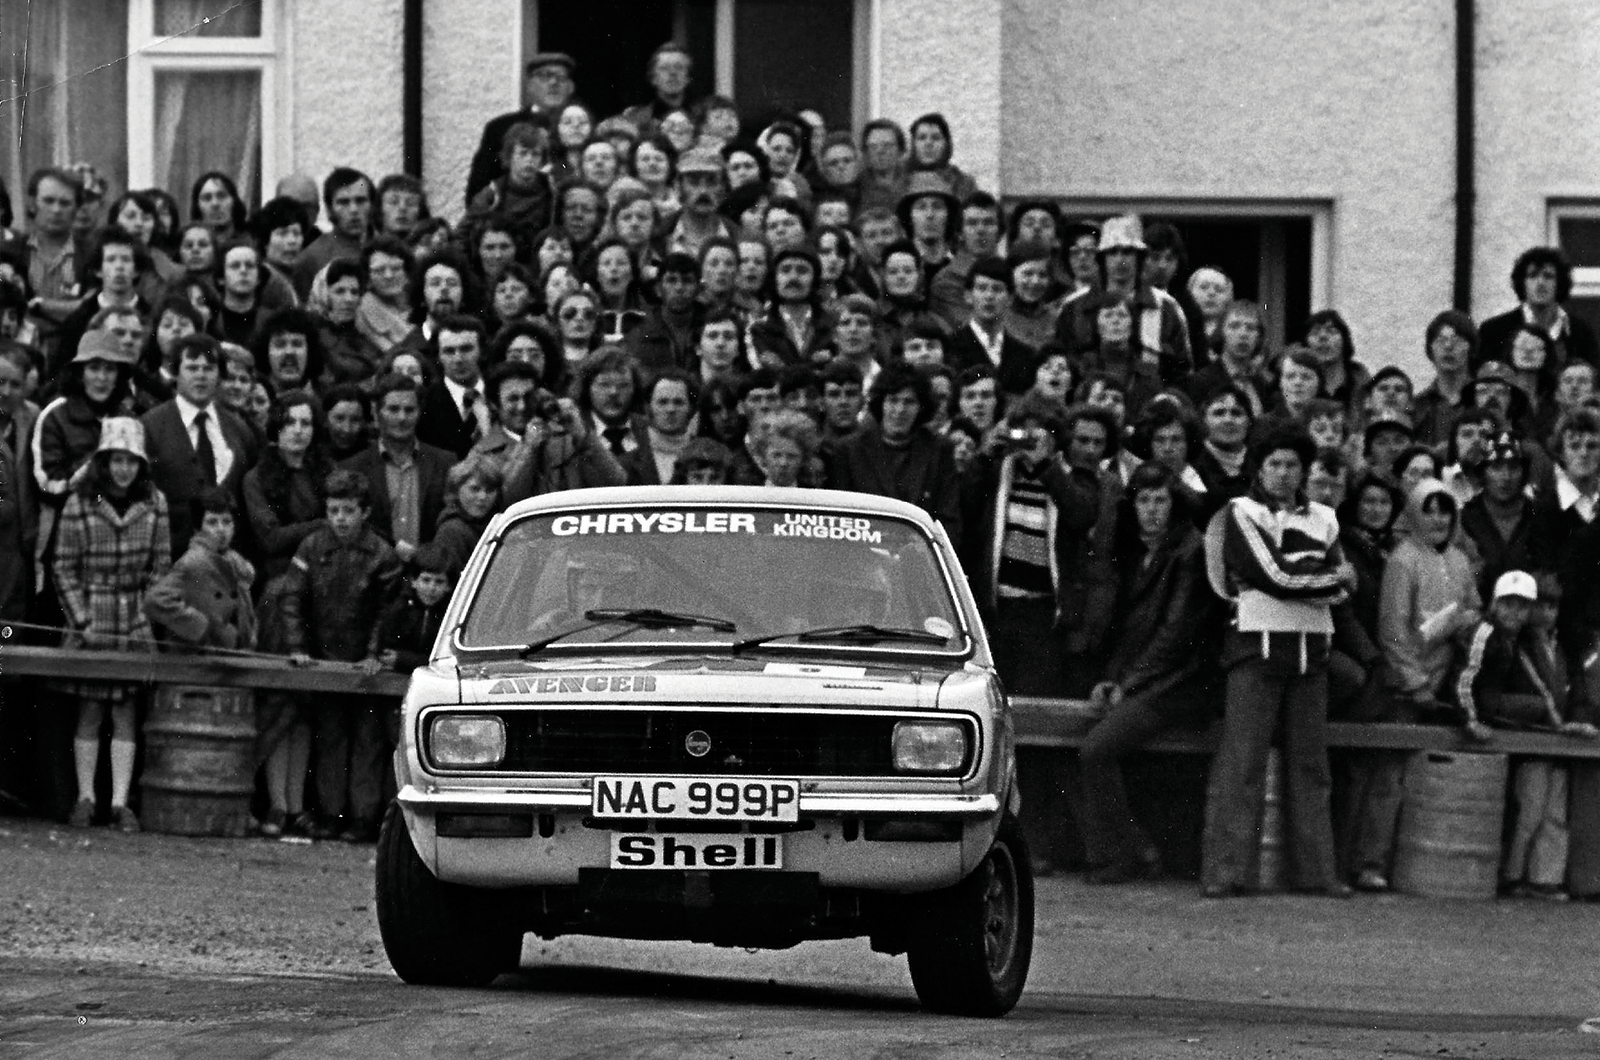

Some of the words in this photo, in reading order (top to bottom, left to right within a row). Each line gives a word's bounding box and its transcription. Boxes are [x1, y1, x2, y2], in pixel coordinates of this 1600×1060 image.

[551, 513, 755, 536] CHRYSLER
[784, 513, 870, 531] UNITED
[773, 523, 882, 543] KINGDOM
[488, 676, 657, 694] AVENGER
[597, 780, 677, 814] NAC
[688, 782, 795, 817] 999P
[616, 836, 776, 866] Shell
